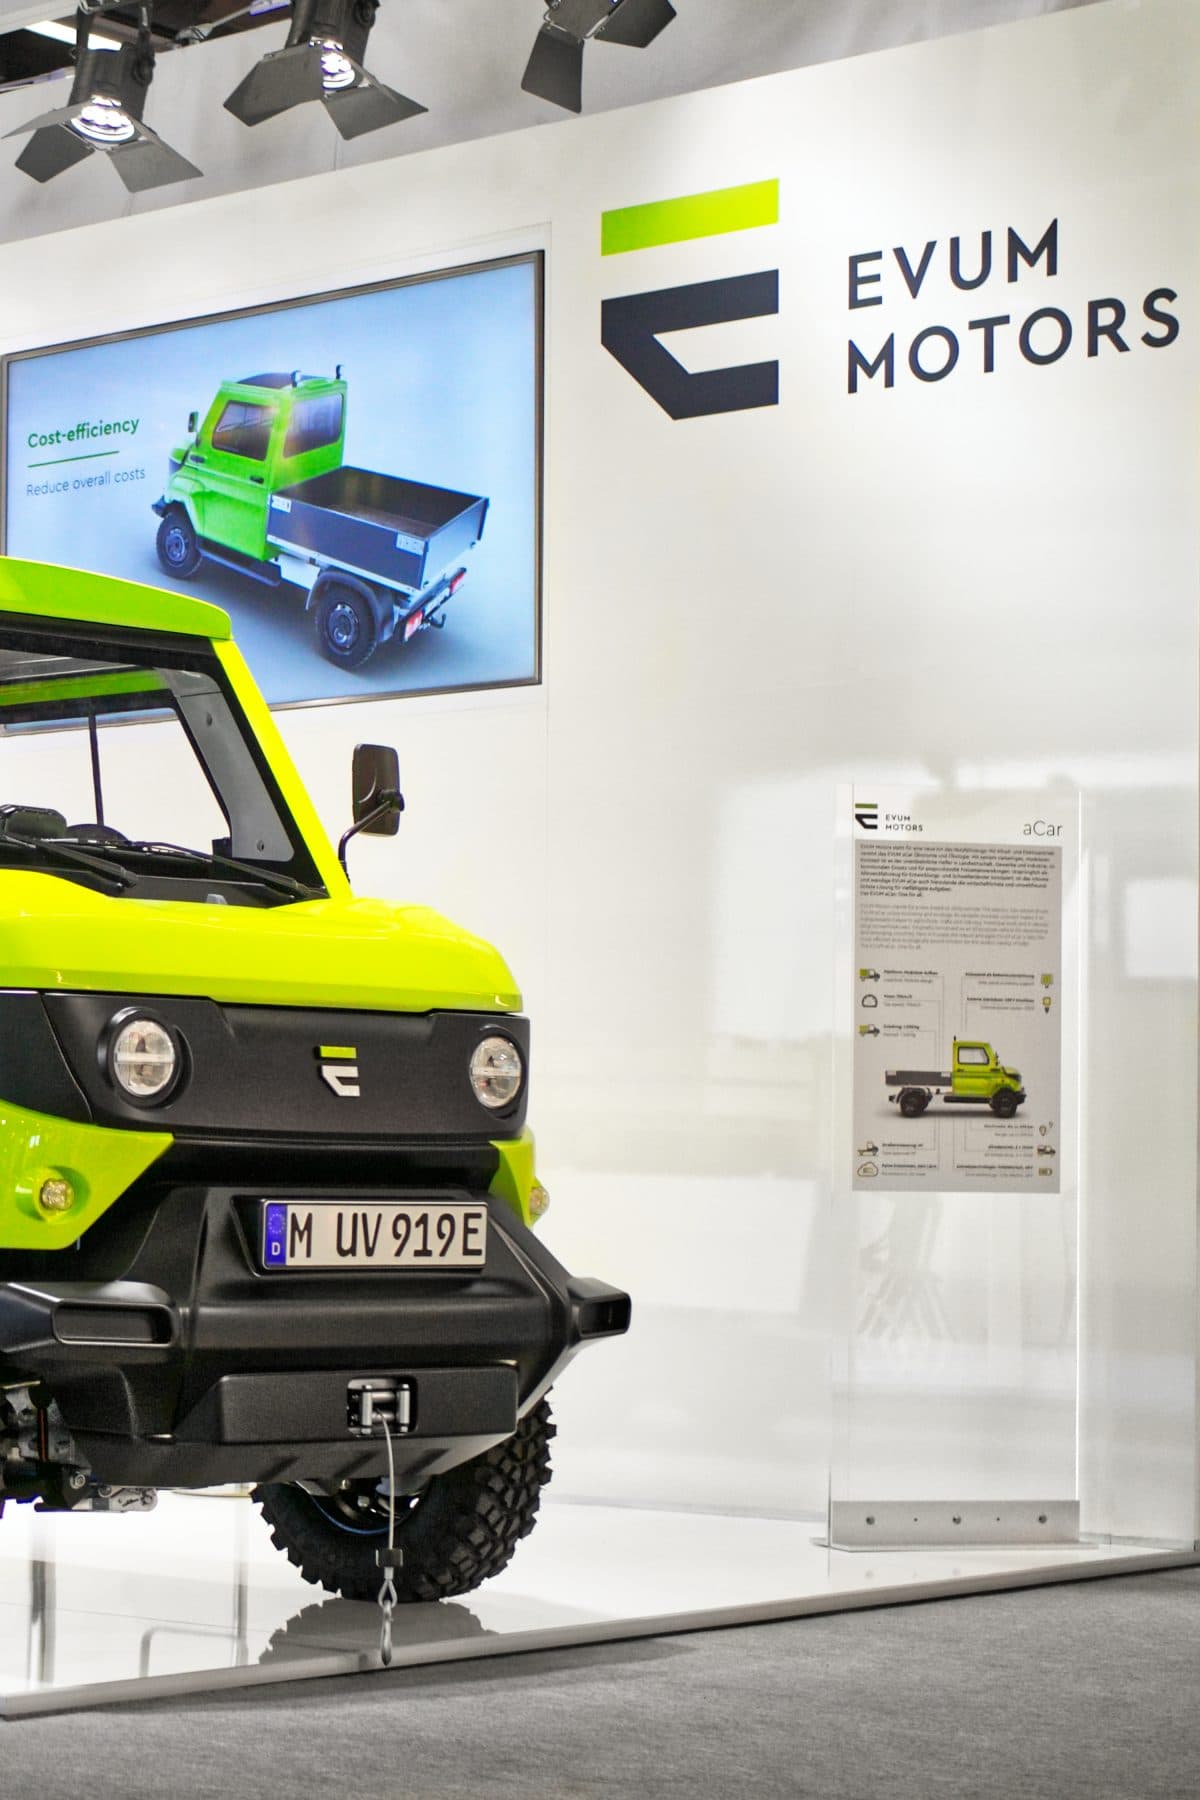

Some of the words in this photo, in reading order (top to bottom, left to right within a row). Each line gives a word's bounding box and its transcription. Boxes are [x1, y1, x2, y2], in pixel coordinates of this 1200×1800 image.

[848, 217, 1058, 310] EVUM
[848, 287, 1180, 394] MOTORS
[27, 419, 140, 448] Cost-efficiency
[26, 480, 70, 496] Reduce
[72, 470, 111, 489] overall
[114, 468, 146, 483] costs
[885, 813, 911, 822] EVUM
[885, 823, 924, 832] MOTORS
[1022, 819, 1063, 837] aCar
[271, 1241, 280, 1256] D
[290, 1212, 313, 1258] M
[336, 1212, 383, 1257] UV
